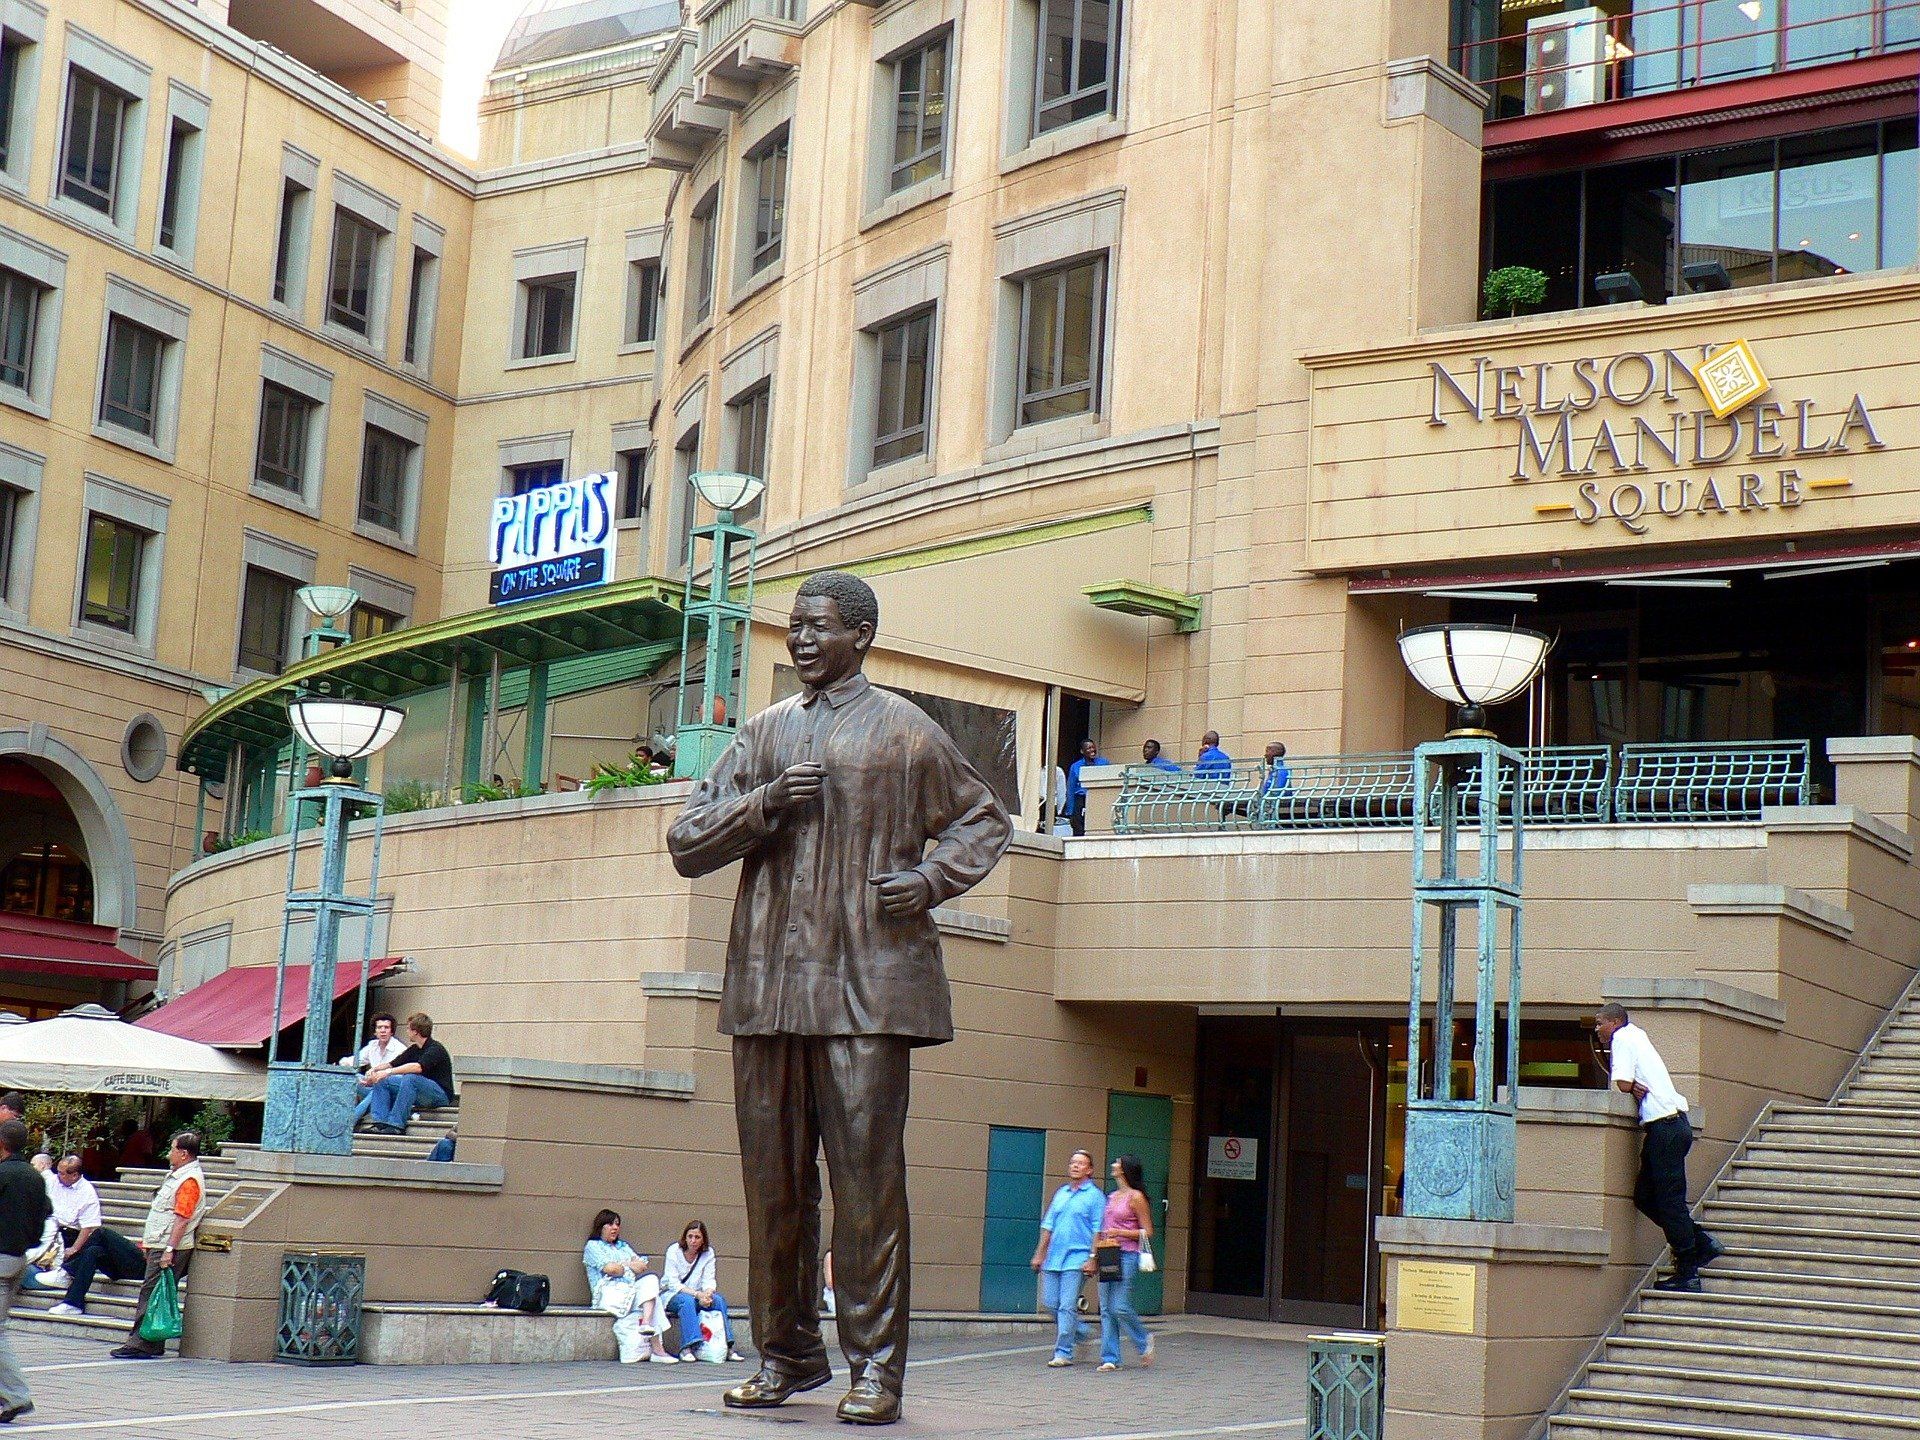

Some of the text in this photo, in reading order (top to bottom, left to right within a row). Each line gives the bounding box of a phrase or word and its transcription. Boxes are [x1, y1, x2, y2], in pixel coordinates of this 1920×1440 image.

[1425, 343, 1717, 426] NELSON
[1510, 393, 1887, 481] MANDELA
[490, 473, 609, 564] PAPPAS
[1573, 469, 1803, 534] SQUARE
[501, 556, 581, 595] ON THE SQUARE
